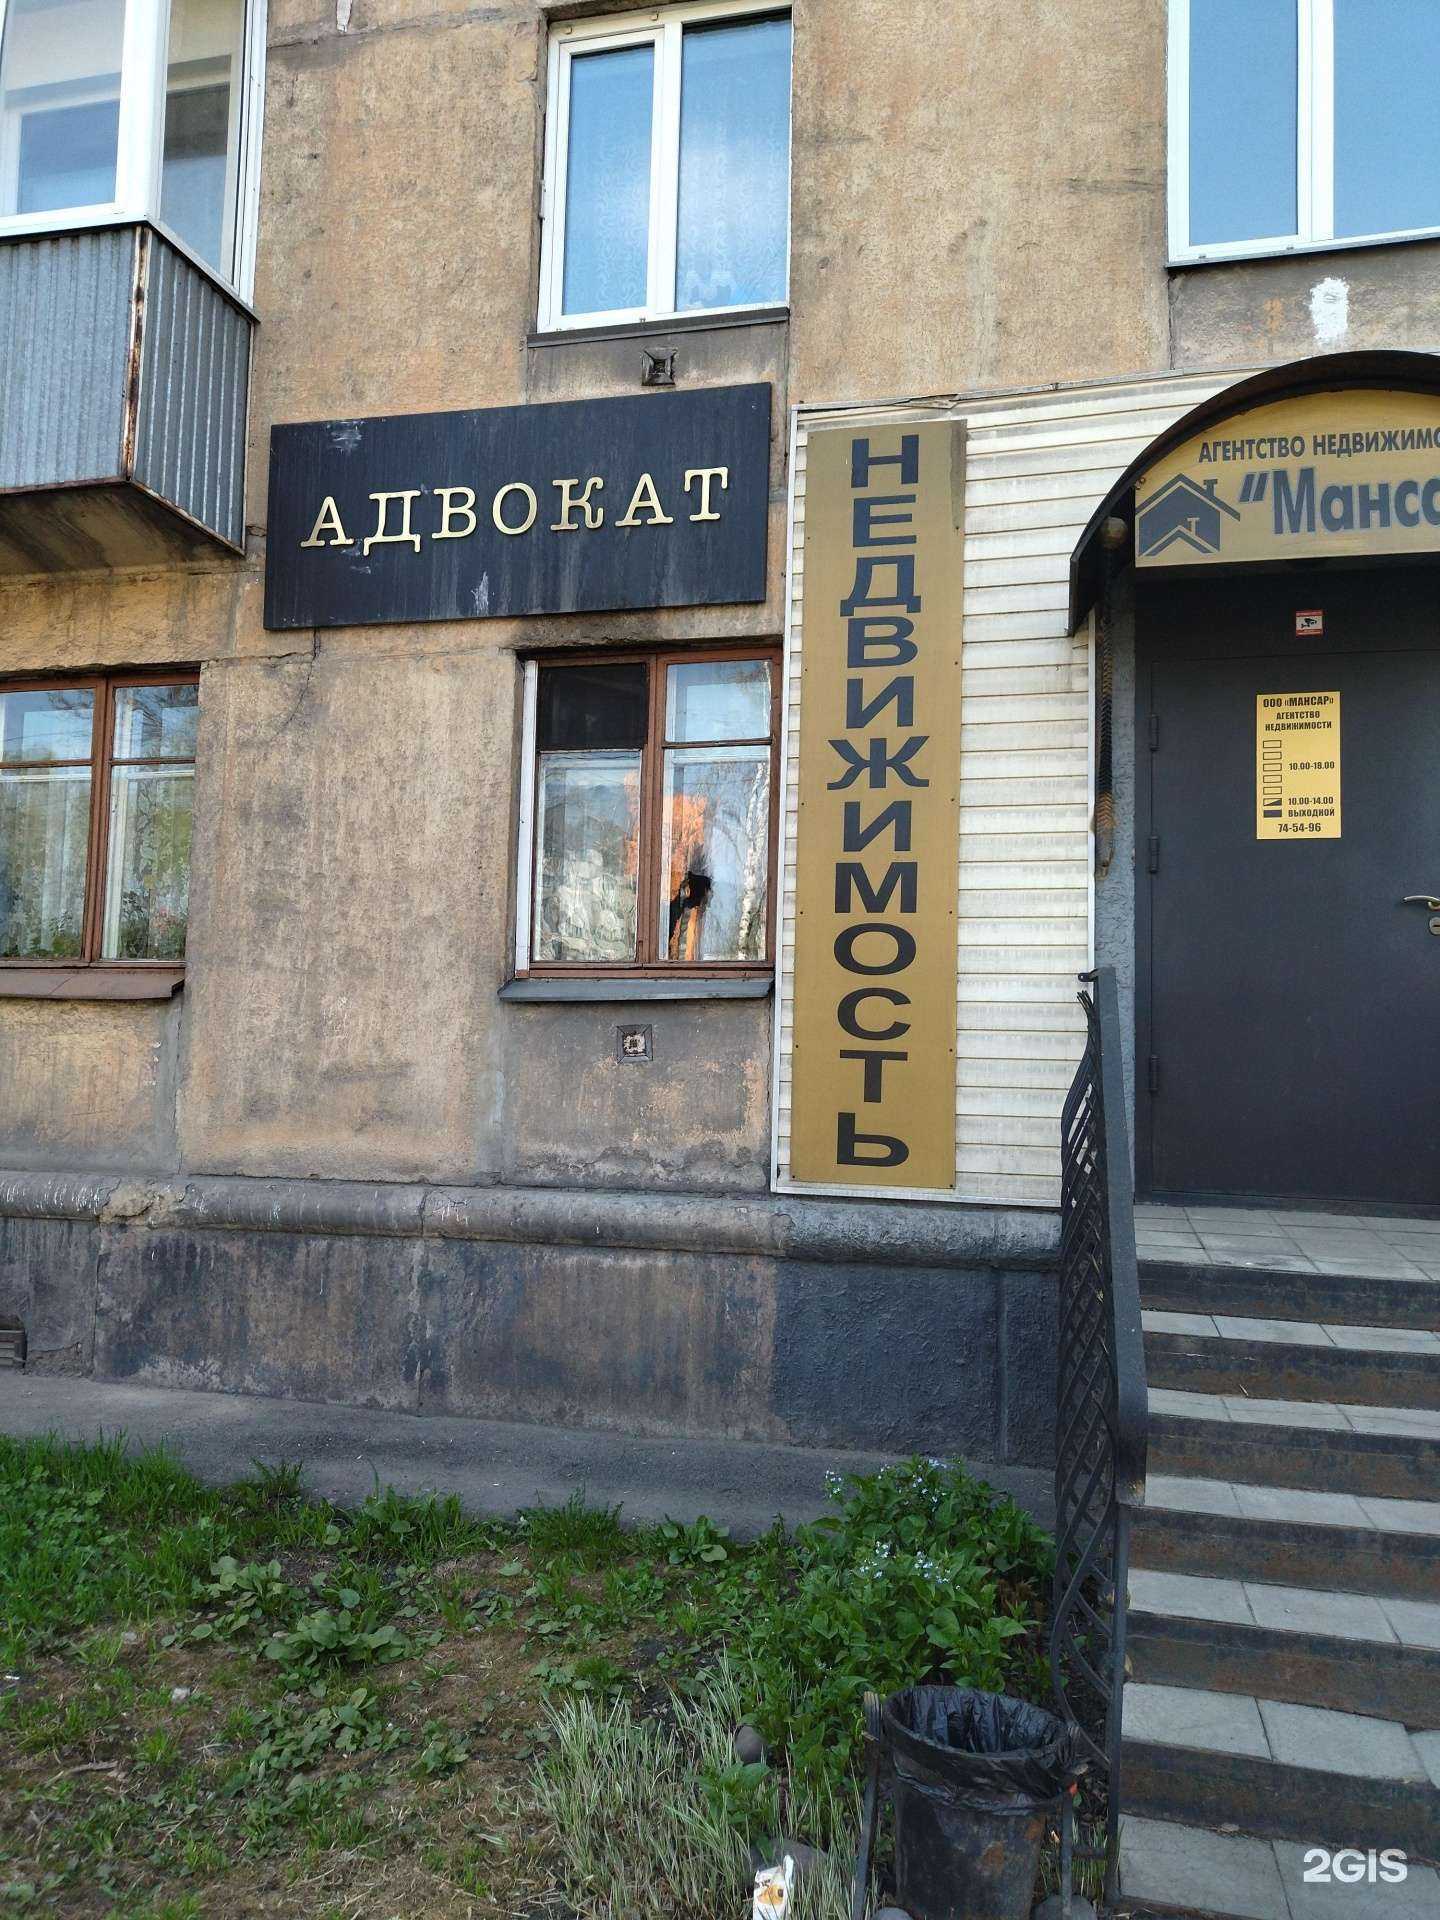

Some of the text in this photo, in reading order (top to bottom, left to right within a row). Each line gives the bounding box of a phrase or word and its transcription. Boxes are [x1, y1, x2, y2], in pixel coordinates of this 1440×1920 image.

[1198, 435, 1306, 463] АГЕНТСТВО
[299, 465, 730, 557] АДВОКАТ
[1263, 697, 1283, 708] ООО
[1276, 710, 1321, 720] АГЕНТСТВО
[1265, 721, 1333, 732] НЕДВИЖИМОСТИ
[1288, 761, 1336, 771] 10.00-18.00
[826, 433, 931, 1169] НЕДВИЖИМОСТЬ
[1288, 796, 1335, 806] 10.00-14.00
[1288, 808, 1336, 818] ВЫХОДНОЙ
[1278, 822, 1323, 833] 74-54-96
